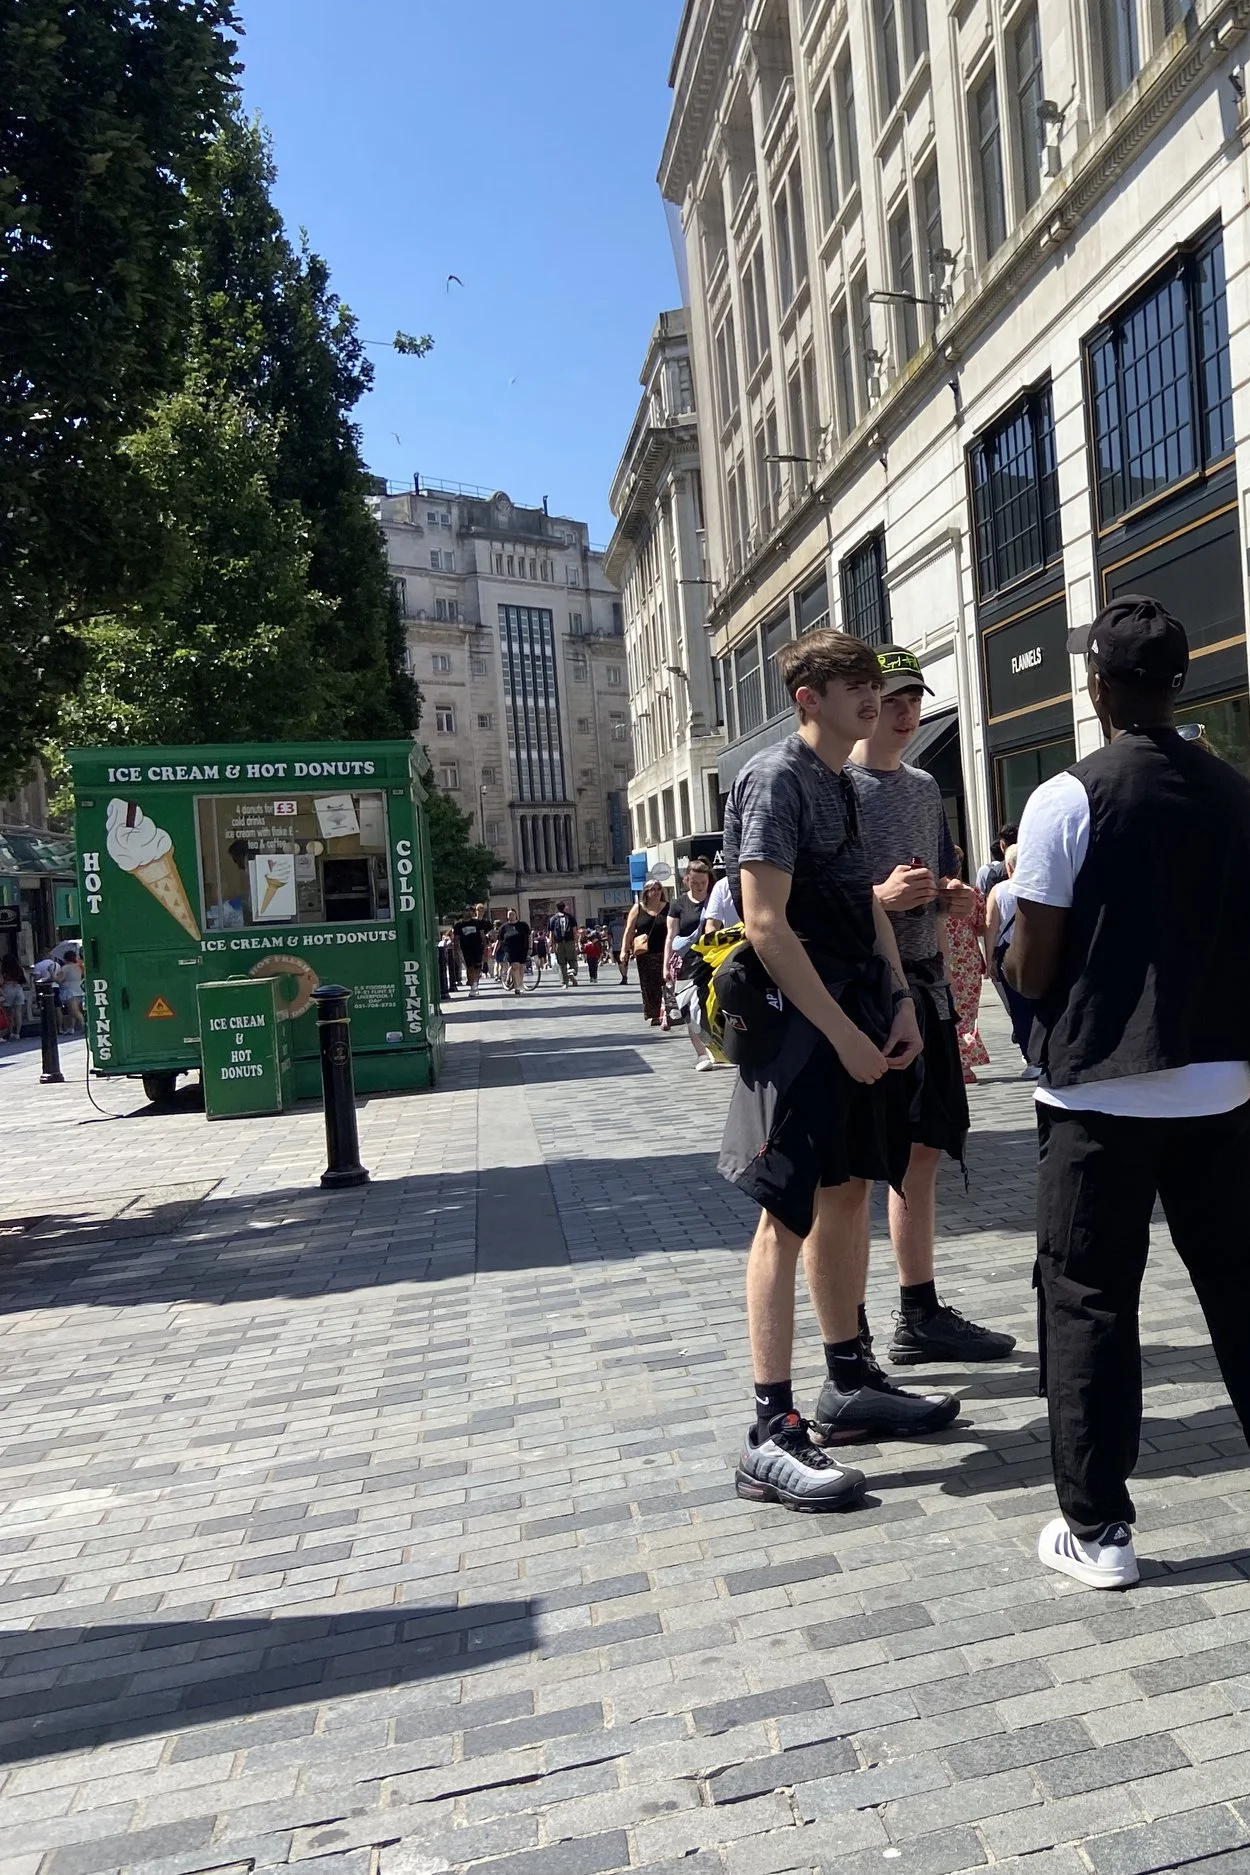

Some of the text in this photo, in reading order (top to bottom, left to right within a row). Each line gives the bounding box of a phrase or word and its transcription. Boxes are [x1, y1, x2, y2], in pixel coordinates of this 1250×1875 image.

[1011, 646, 1042, 674] FLANNELS
[107, 761, 375, 783] ICE CREAM & HOT DONUTS
[242, 803, 264, 814] donuts
[276, 802, 295, 814] £3
[231, 815, 266, 827] cold drinks
[225, 828, 235, 839] ice
[235, 829, 256, 838] cream
[256, 827, 271, 837] with
[247, 839, 259, 850] tea
[83, 852, 103, 914] HOT
[396, 839, 416, 912] COLD
[201, 930, 397, 952] ICE CREAM & HOT DONUTS
[403, 960, 423, 1034] DRINKS
[93, 979, 113, 1061] DRINKS
[209, 1017, 228, 1031] ICE
[229, 1014, 266, 1029] CREAM
[235, 1032, 244, 1045] &
[231, 1049, 252, 1063] HOT
[220, 1064, 263, 1080] DONUTS
